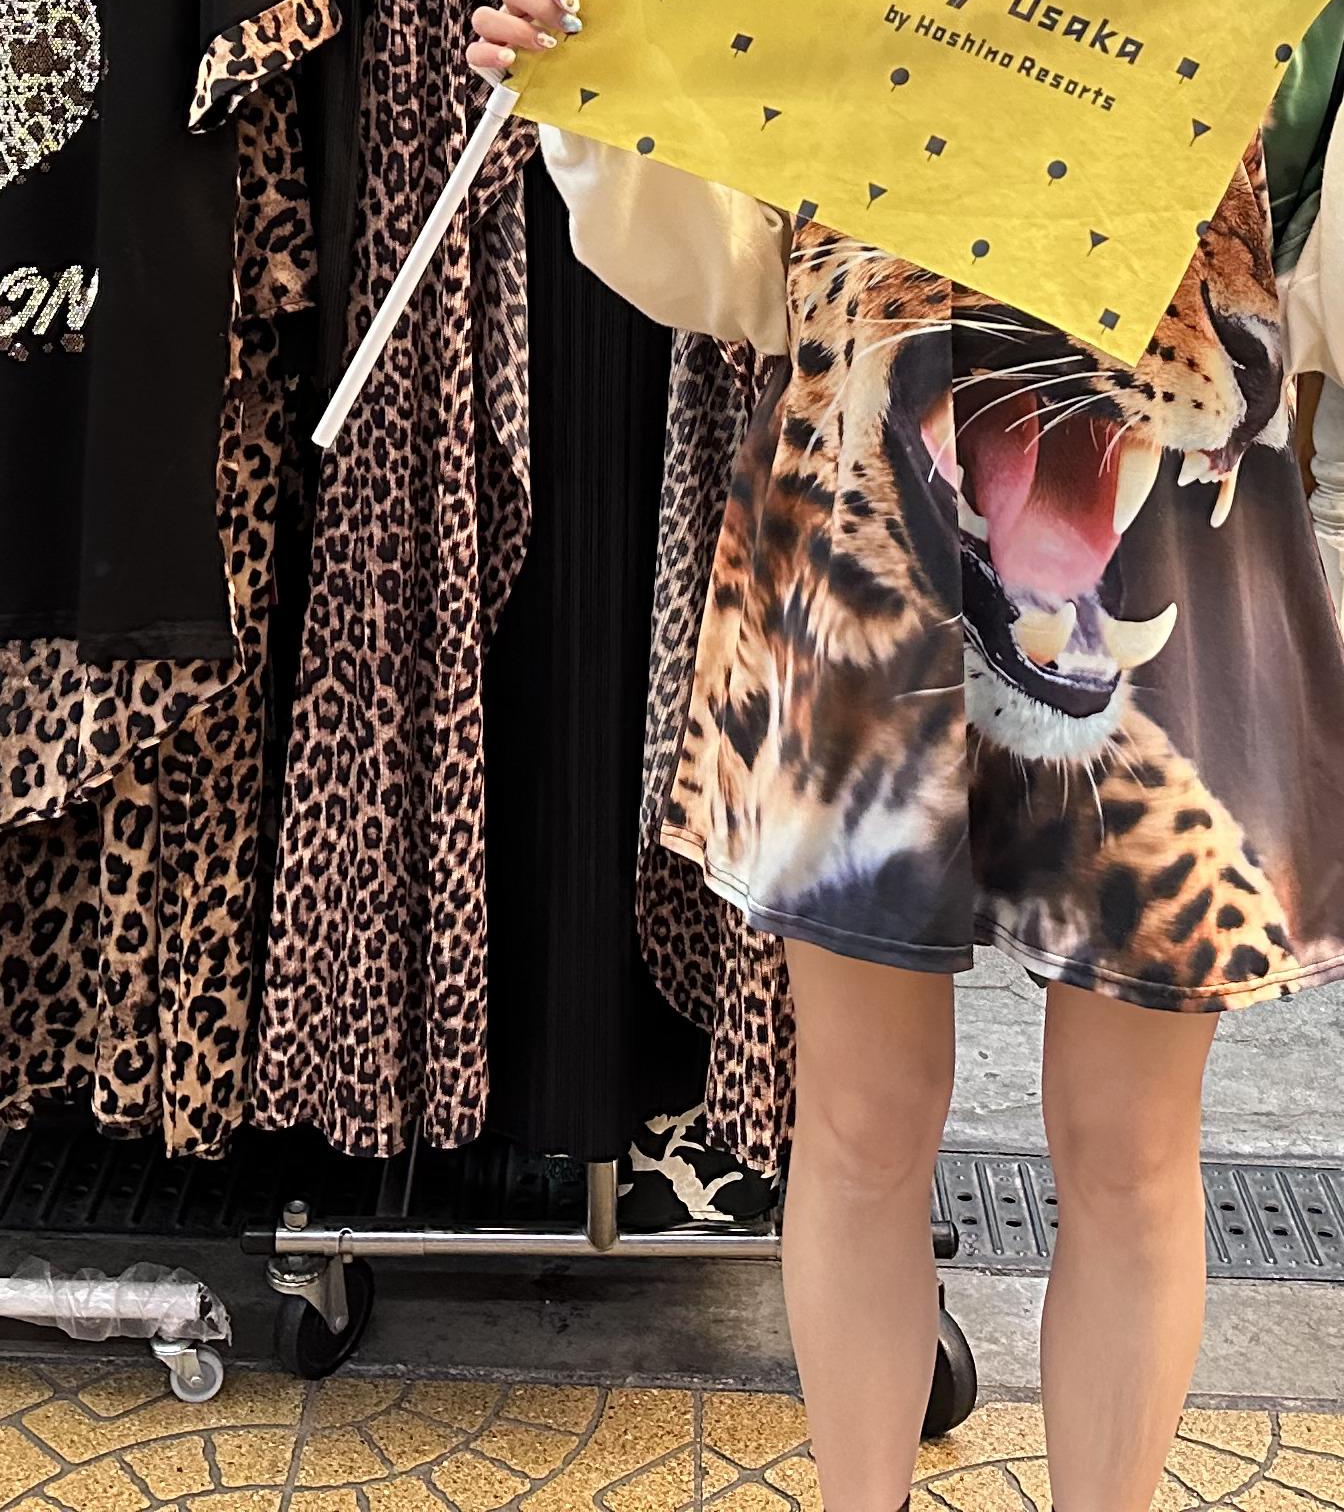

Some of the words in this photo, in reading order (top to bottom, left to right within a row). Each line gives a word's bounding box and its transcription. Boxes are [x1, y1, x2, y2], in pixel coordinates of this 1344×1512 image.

[883, 3, 912, 33] by
[913, 13, 1015, 69] Hoshino
[1016, 54, 1117, 112] Resorts
